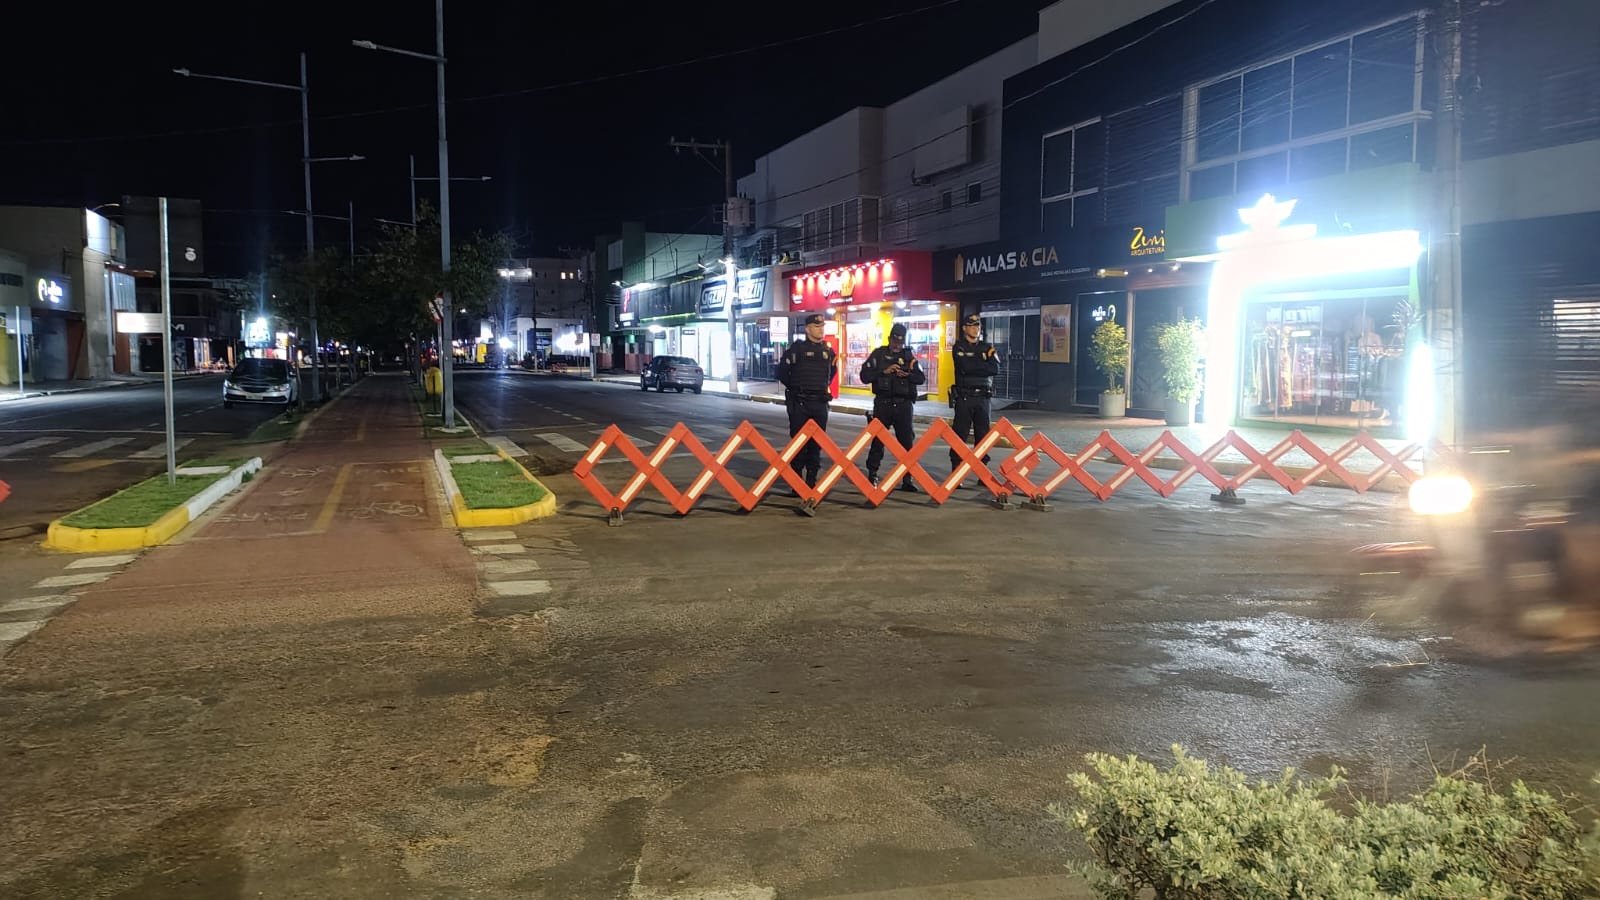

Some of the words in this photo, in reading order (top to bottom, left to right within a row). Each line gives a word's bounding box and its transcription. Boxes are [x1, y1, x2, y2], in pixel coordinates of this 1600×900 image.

[965, 252, 1017, 276] MALAS
[1019, 251, 1028, 268] &
[1032, 246, 1059, 266] CIA
[1130, 247, 1166, 256] ARQUITETURA
